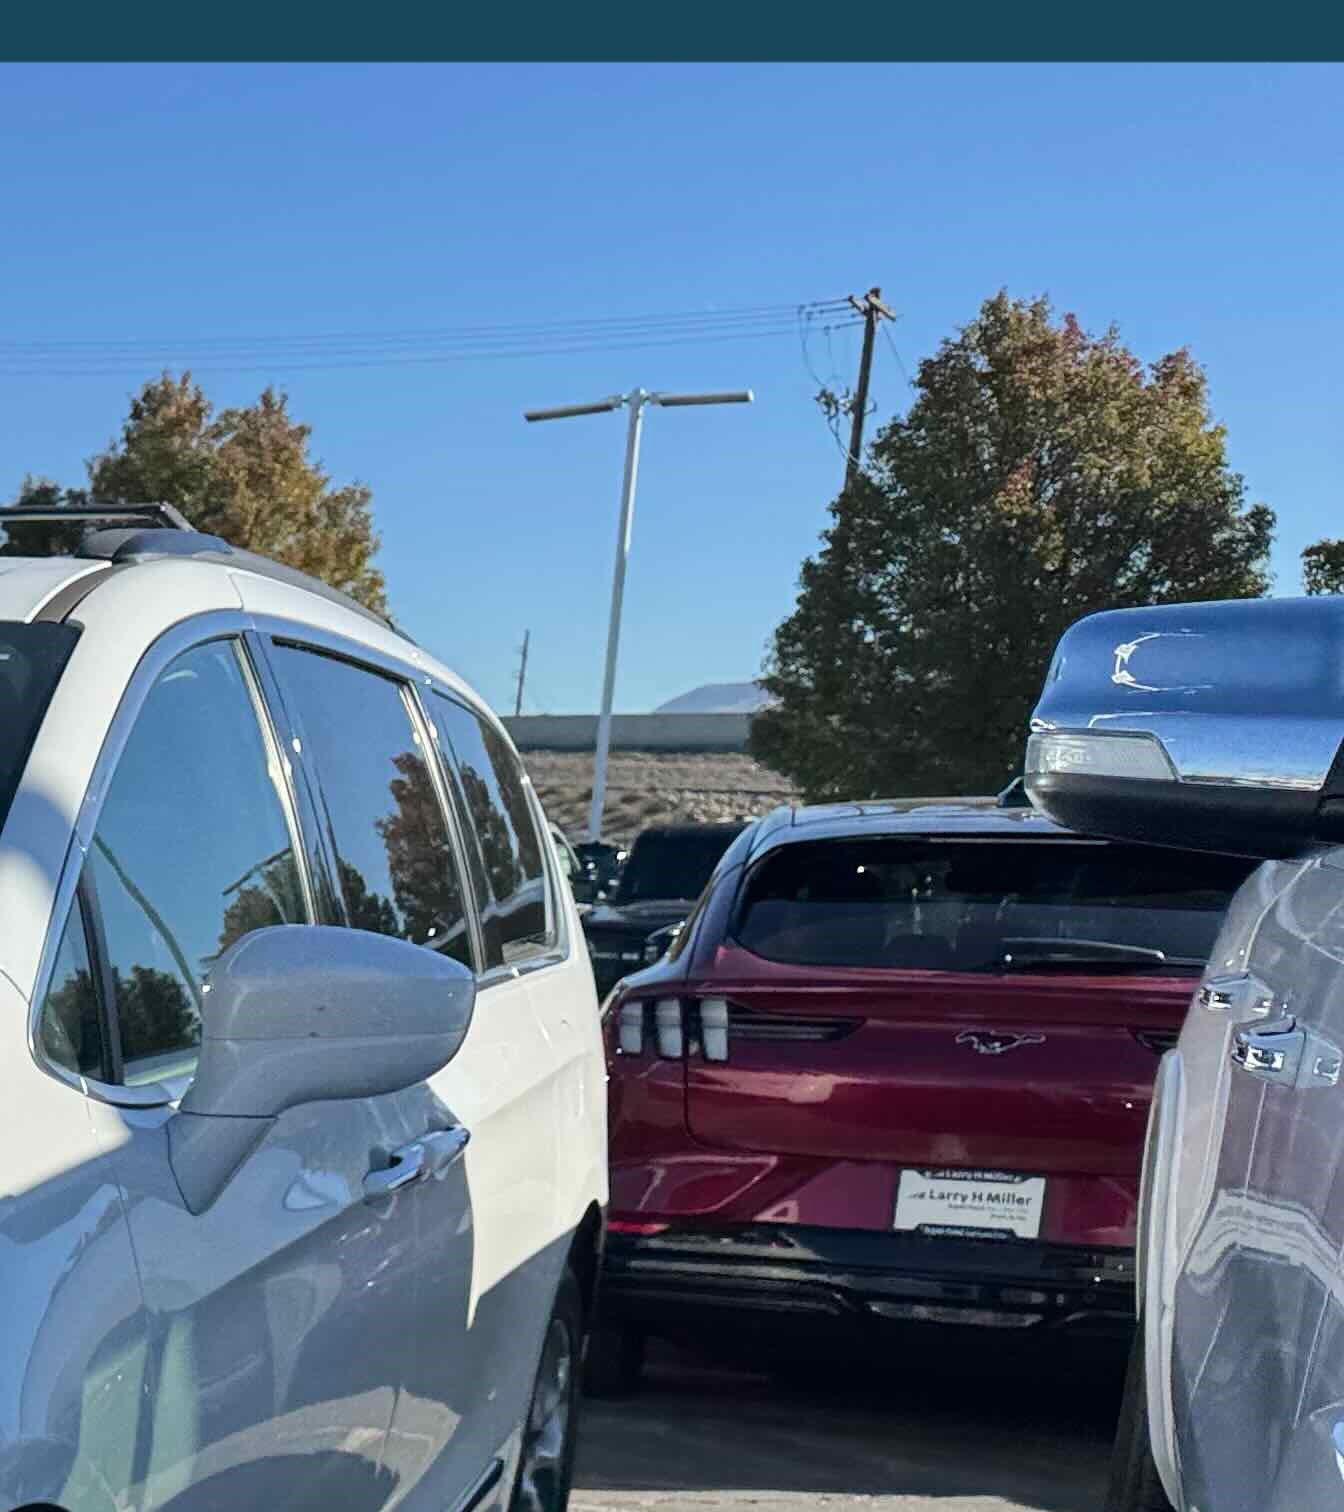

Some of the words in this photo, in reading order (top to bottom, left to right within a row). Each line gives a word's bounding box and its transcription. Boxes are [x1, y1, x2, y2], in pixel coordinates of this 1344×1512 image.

[928, 1188, 969, 1203] Larry
[971, 1191, 983, 1202] H
[986, 1191, 1032, 1206] Miller
